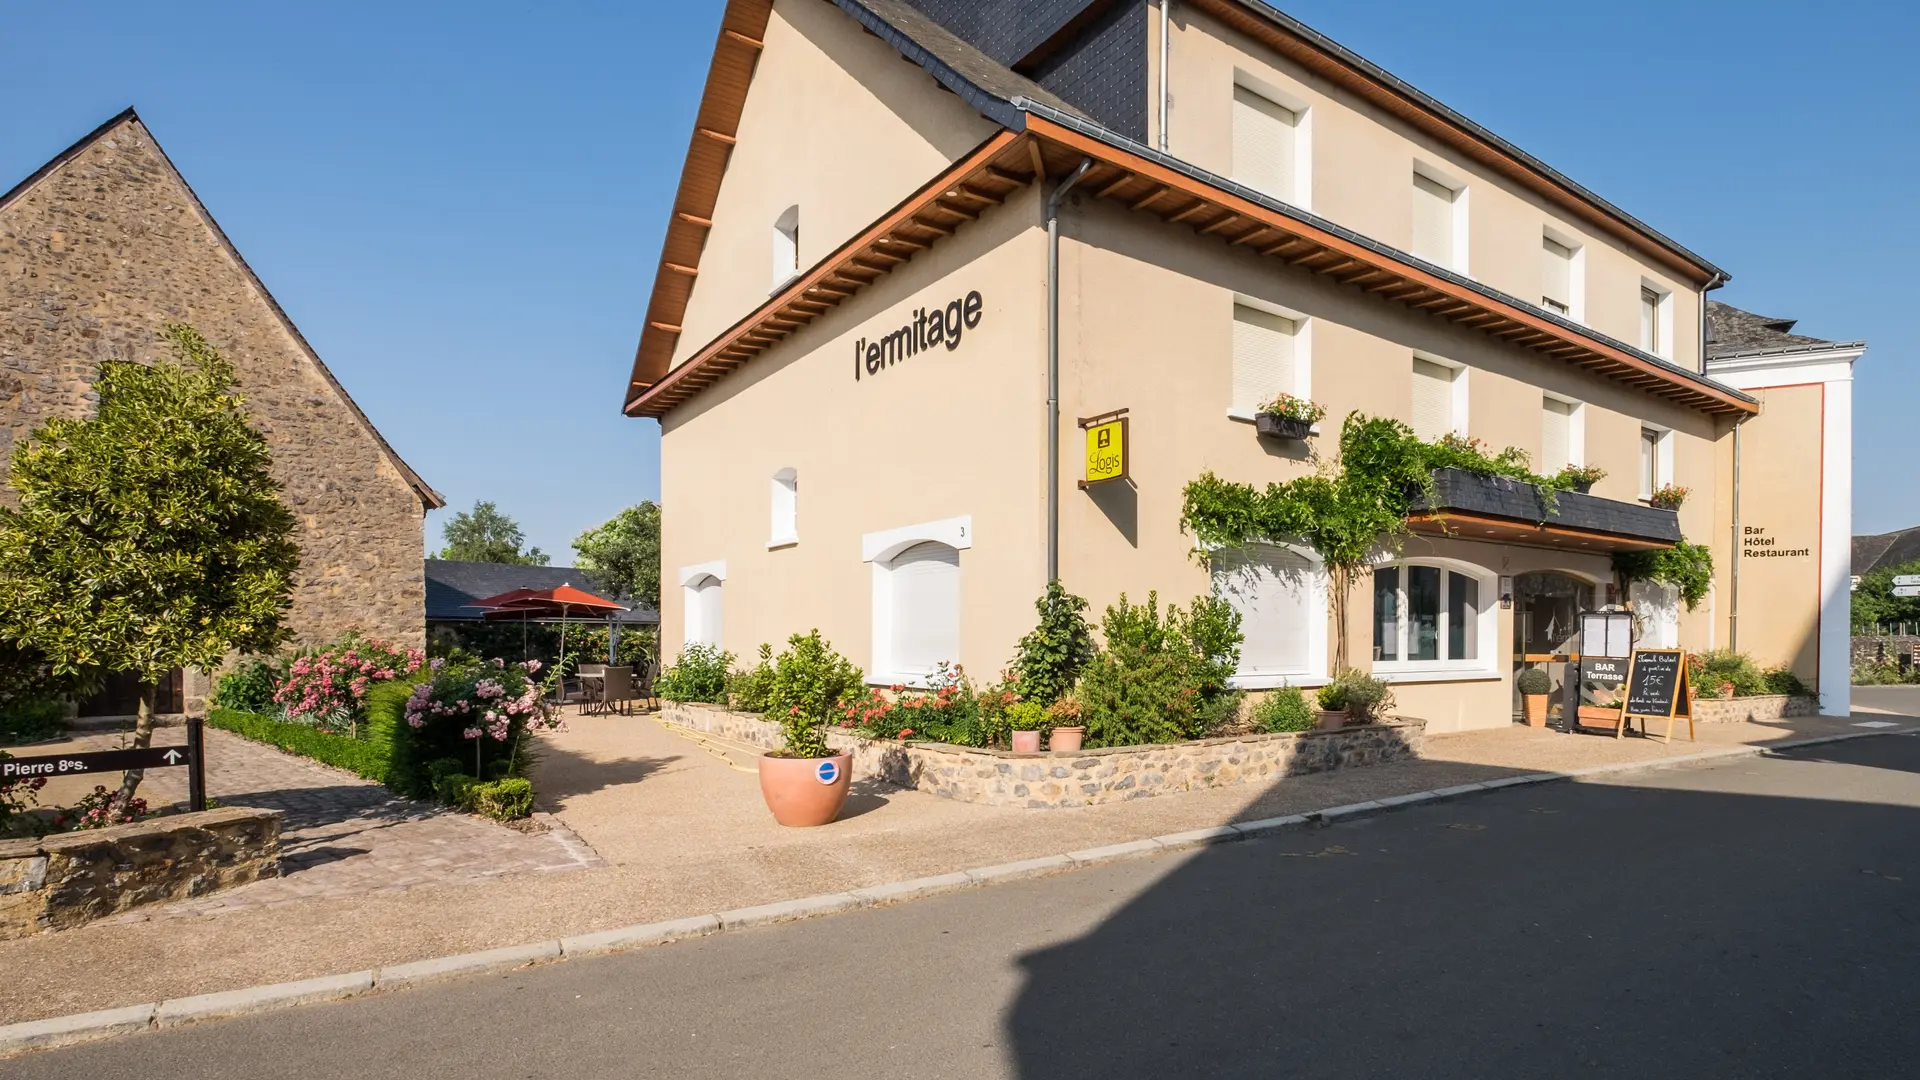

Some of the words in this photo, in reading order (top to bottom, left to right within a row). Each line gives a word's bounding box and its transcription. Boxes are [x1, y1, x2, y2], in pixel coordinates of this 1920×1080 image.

[855, 290, 983, 381] l'ermitage
[1089, 449, 1120, 475] Logis
[960, 526, 965, 538] 3
[1744, 526, 1765, 535] Bar
[1744, 537, 1775, 546] Hôtel
[1744, 548, 1810, 558] Restaurant
[1595, 663, 1615, 672] BAR
[1586, 671, 1624, 681] Terrasse
[1642, 675, 1664, 686] 15€
[4, 763, 54, 776] Pierre
